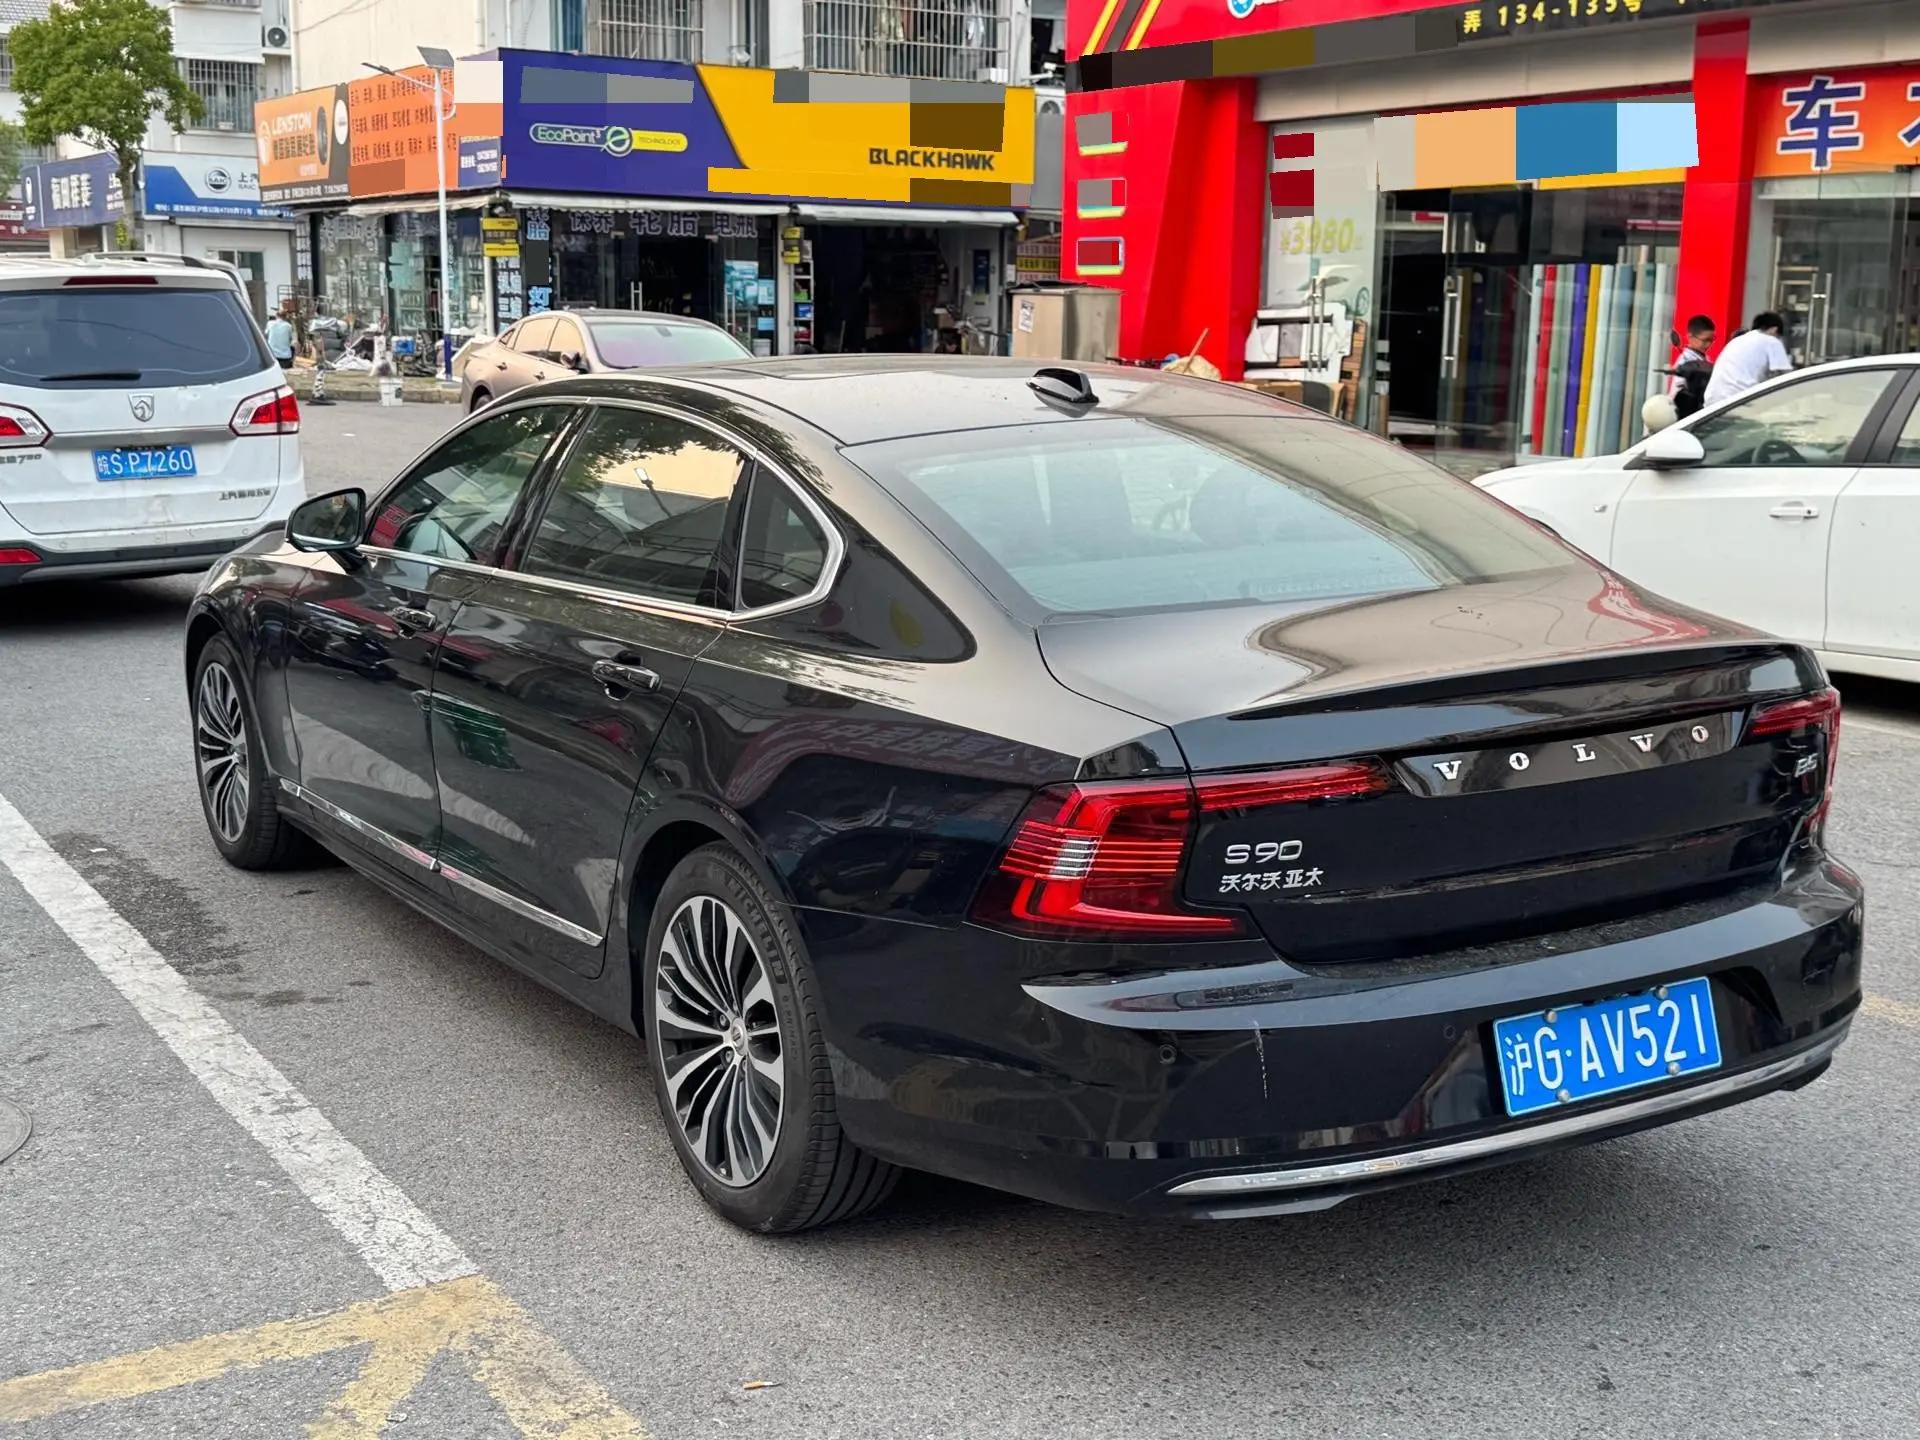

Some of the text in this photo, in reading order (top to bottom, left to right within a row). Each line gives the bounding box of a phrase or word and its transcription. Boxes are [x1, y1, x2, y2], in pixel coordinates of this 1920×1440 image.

[869, 148, 996, 171] BLACKHAWK
[630, 211, 699, 237] 轮胎
[713, 213, 758, 238] 电瓶
[1433, 725, 1711, 782] VOLVO
[1224, 839, 1303, 864] S90
[1218, 867, 1325, 893] 沃尔沃亚太
